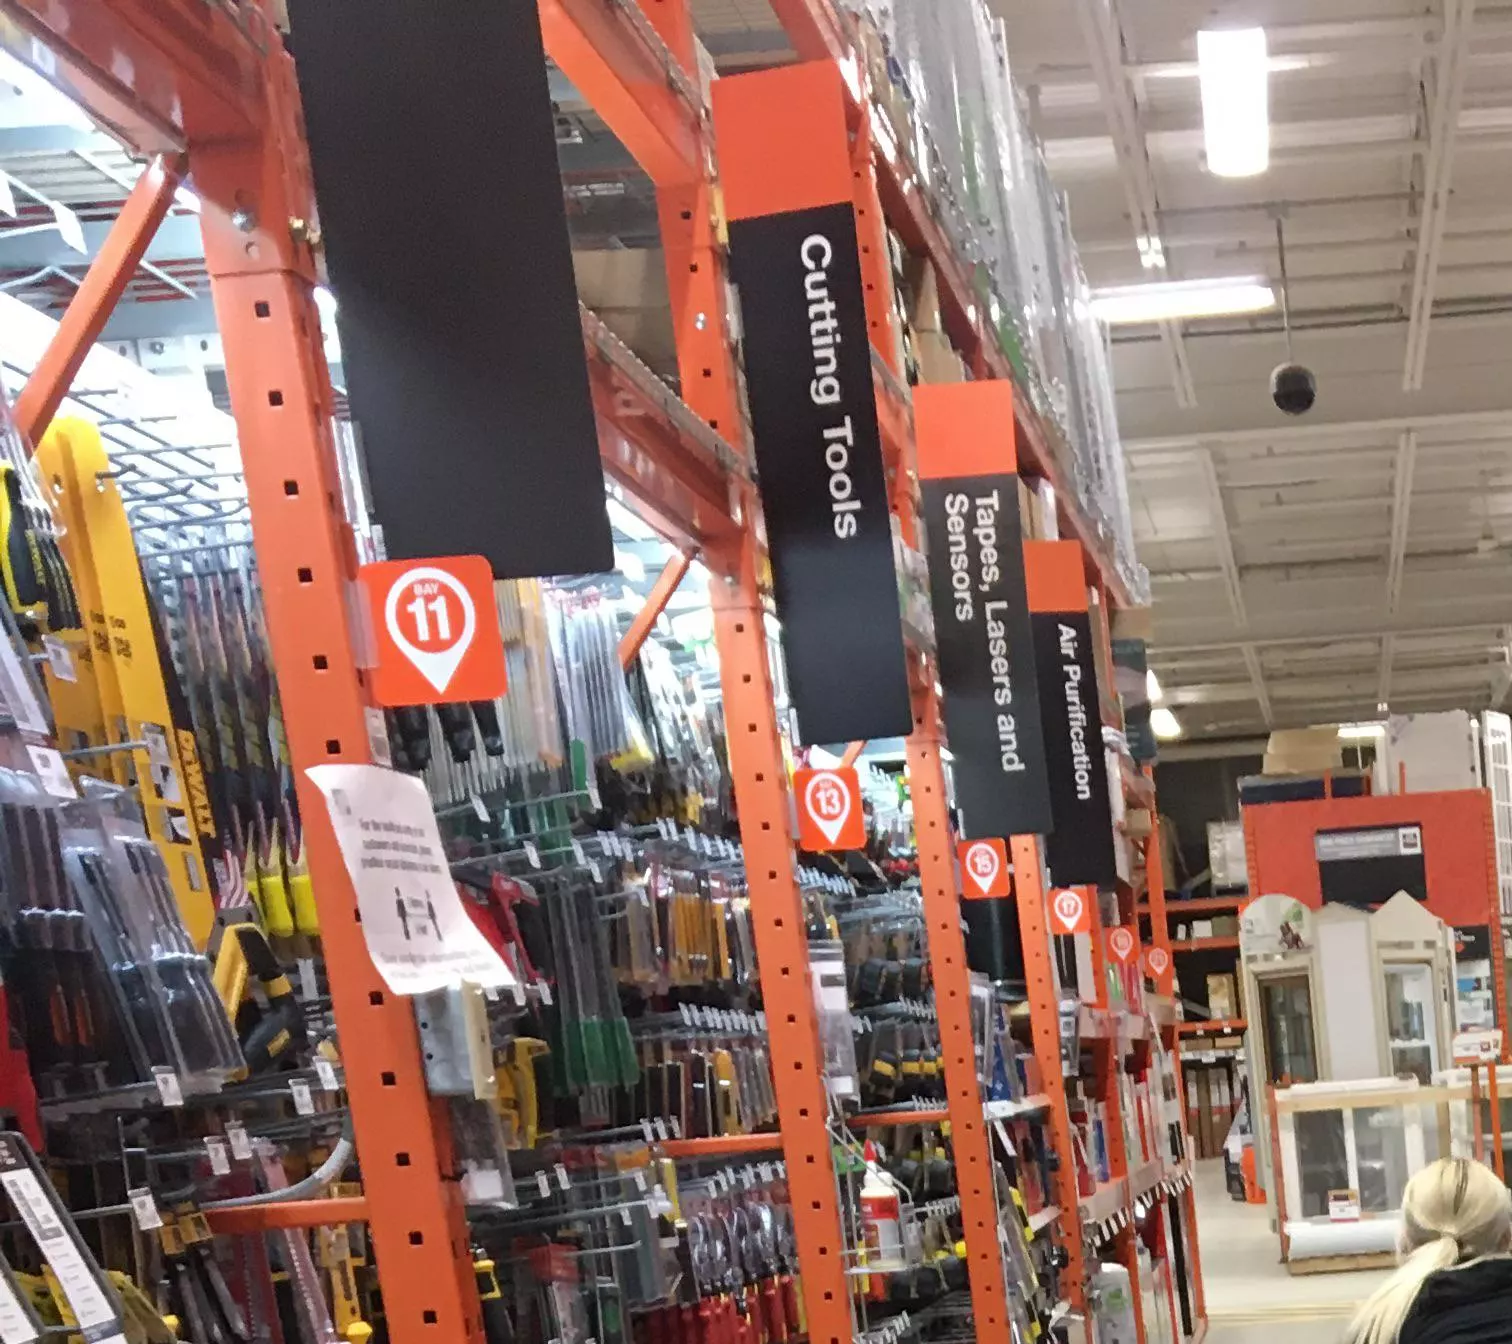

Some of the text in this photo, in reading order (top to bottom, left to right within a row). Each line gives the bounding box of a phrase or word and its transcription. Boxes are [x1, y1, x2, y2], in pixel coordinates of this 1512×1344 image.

[801, 234, 862, 538] Cutting Tools
[407, 595, 451, 641] 11
[944, 492, 973, 622] Sensors
[973, 489, 1025, 773] Tapes, Lasers and
[1058, 622, 1092, 801] Air Purification
[816, 788, 841, 816] 13
